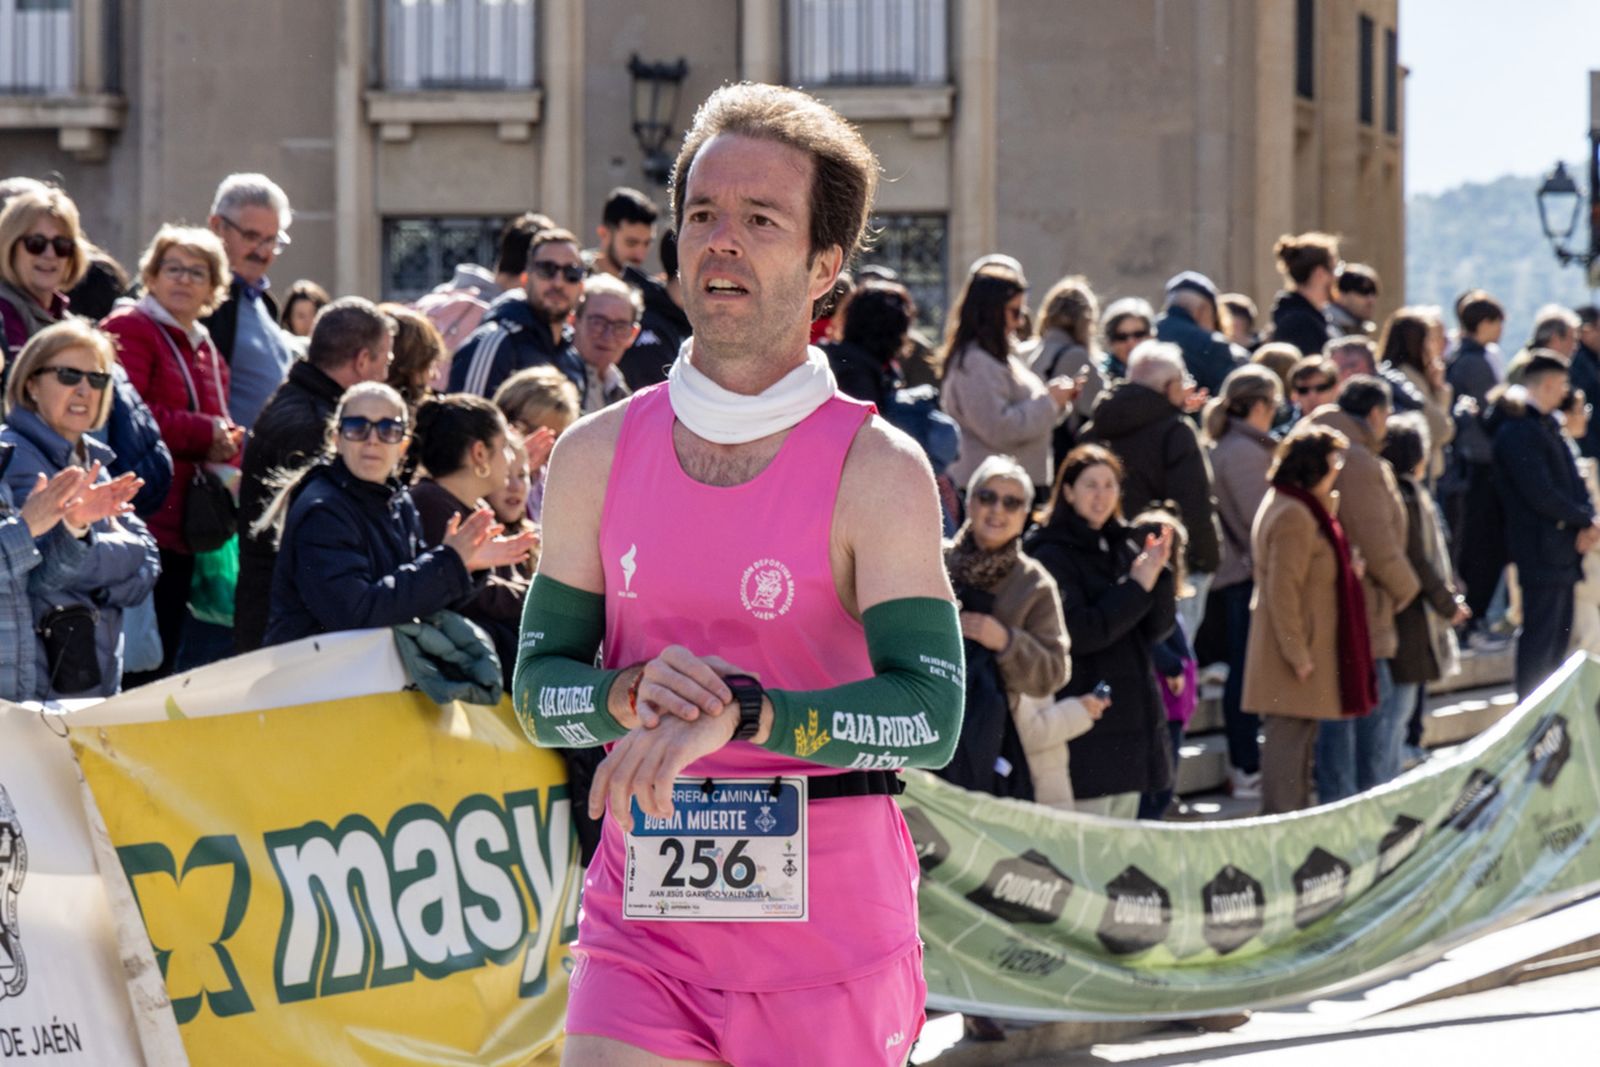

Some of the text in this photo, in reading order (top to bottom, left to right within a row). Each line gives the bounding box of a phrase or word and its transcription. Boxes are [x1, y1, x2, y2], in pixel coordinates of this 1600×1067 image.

[556, 685, 596, 717] RURAL
[832, 710, 940, 748] CAJA RURAL
[845, 751, 909, 769] JAÉN
[670, 789, 709, 803] RRERA
[644, 809, 747, 831] BUENA MUERTE
[659, 837, 756, 889] 256
[266, 785, 582, 1000] masy
[648, 888, 771, 899] JUAN JESÚS GARRIDO VALENZUELA
[993, 871, 1063, 912] ownat
[0, 1015, 83, 1057] DE JAÉN
